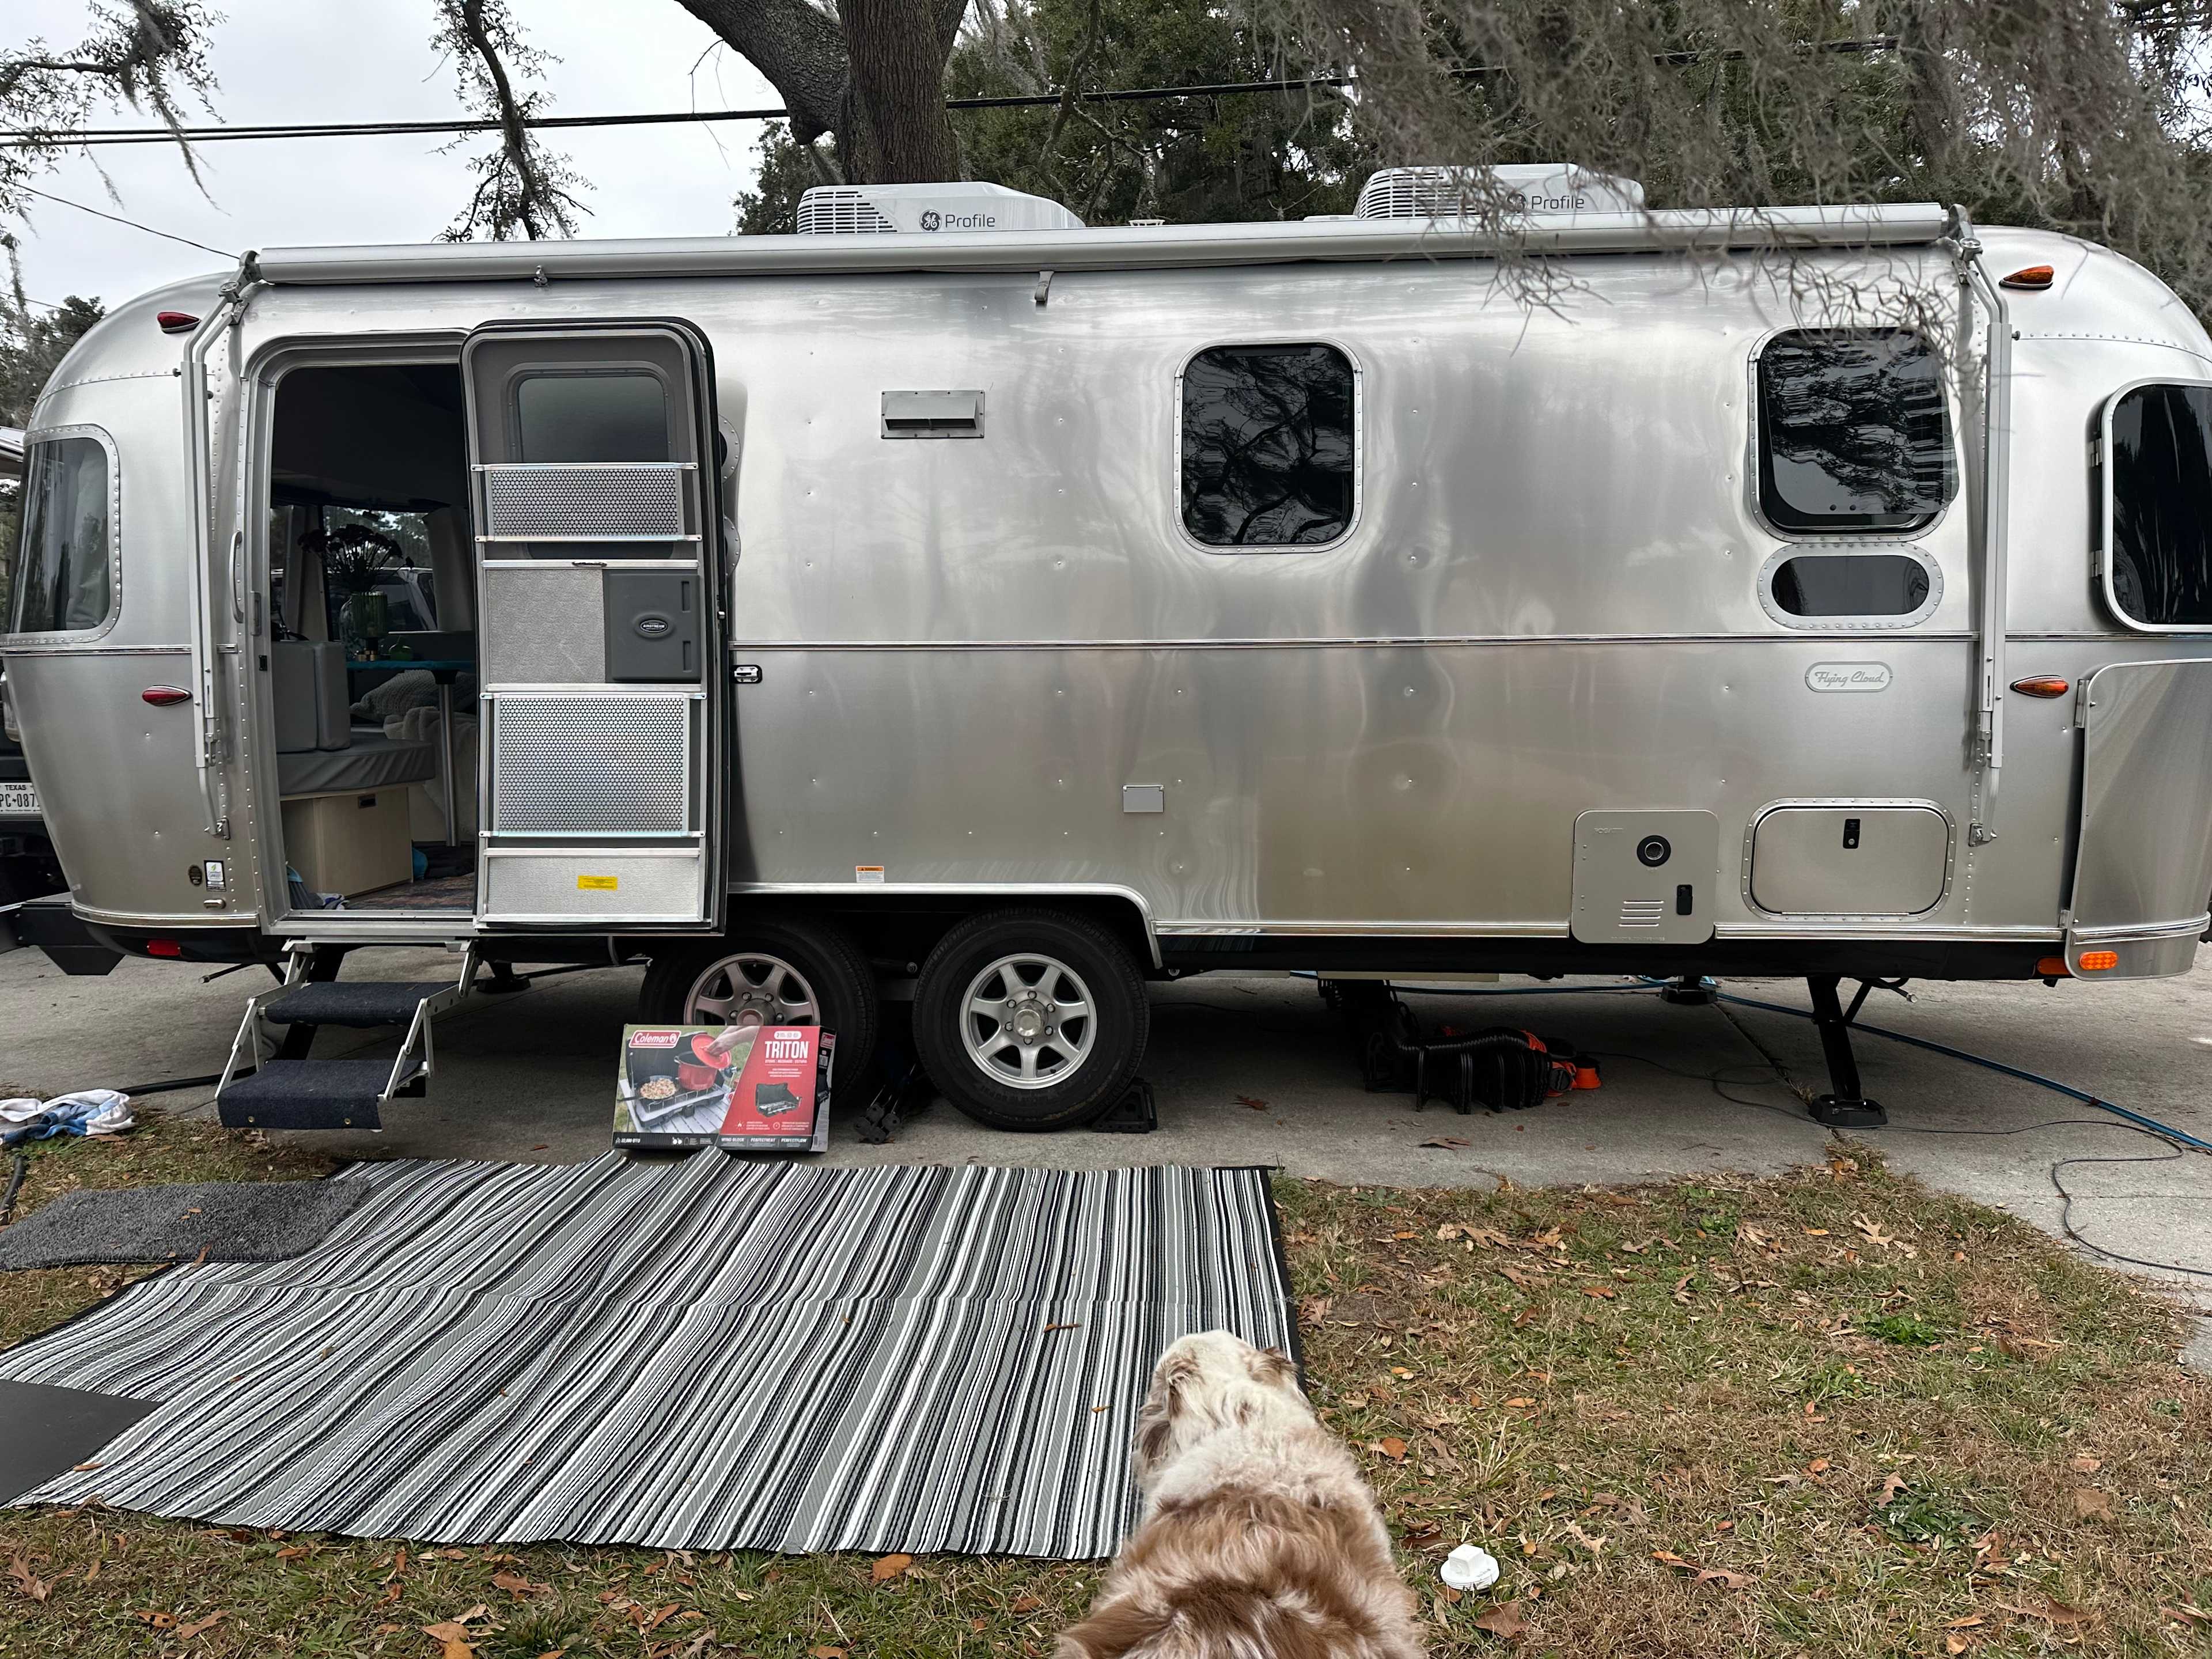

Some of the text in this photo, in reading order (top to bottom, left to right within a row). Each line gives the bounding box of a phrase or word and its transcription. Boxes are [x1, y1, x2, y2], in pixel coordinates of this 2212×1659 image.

[1532, 195, 1584, 209] Profile
[945, 214, 995, 228] Profile
[1815, 671, 1884, 687] Flying Cloud
[635, 1032, 669, 1043] Coleman
[765, 1041, 809, 1059] TRITON
